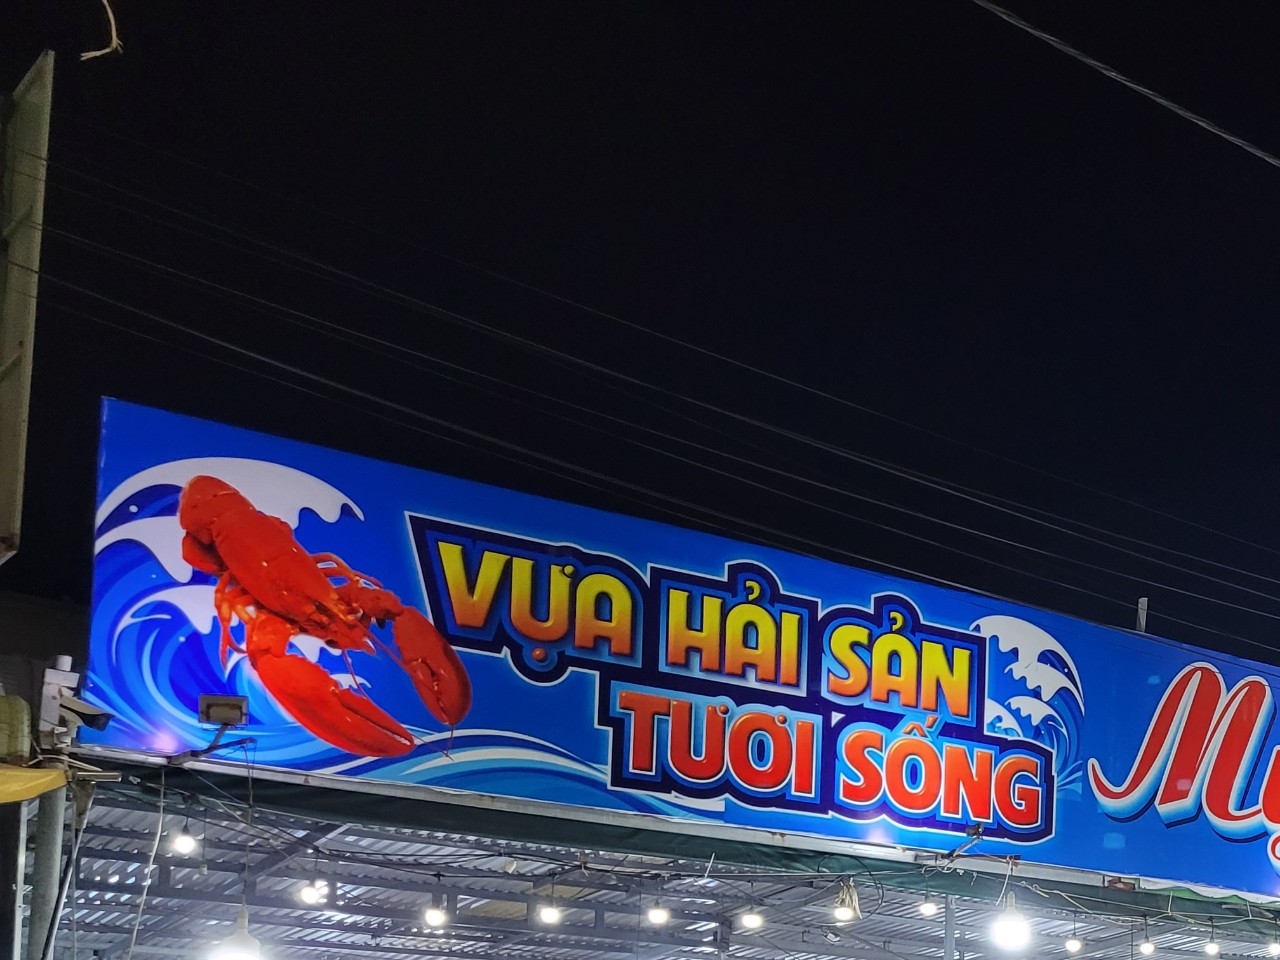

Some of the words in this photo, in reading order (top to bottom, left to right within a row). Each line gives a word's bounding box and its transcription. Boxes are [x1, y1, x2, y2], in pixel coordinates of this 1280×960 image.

[436, 540, 634, 664] VỰA
[666, 580, 803, 687] HẢI
[826, 609, 975, 718] SẢN
[616, 690, 820, 797] TƯƠI
[837, 713, 1042, 828] SỐNG
